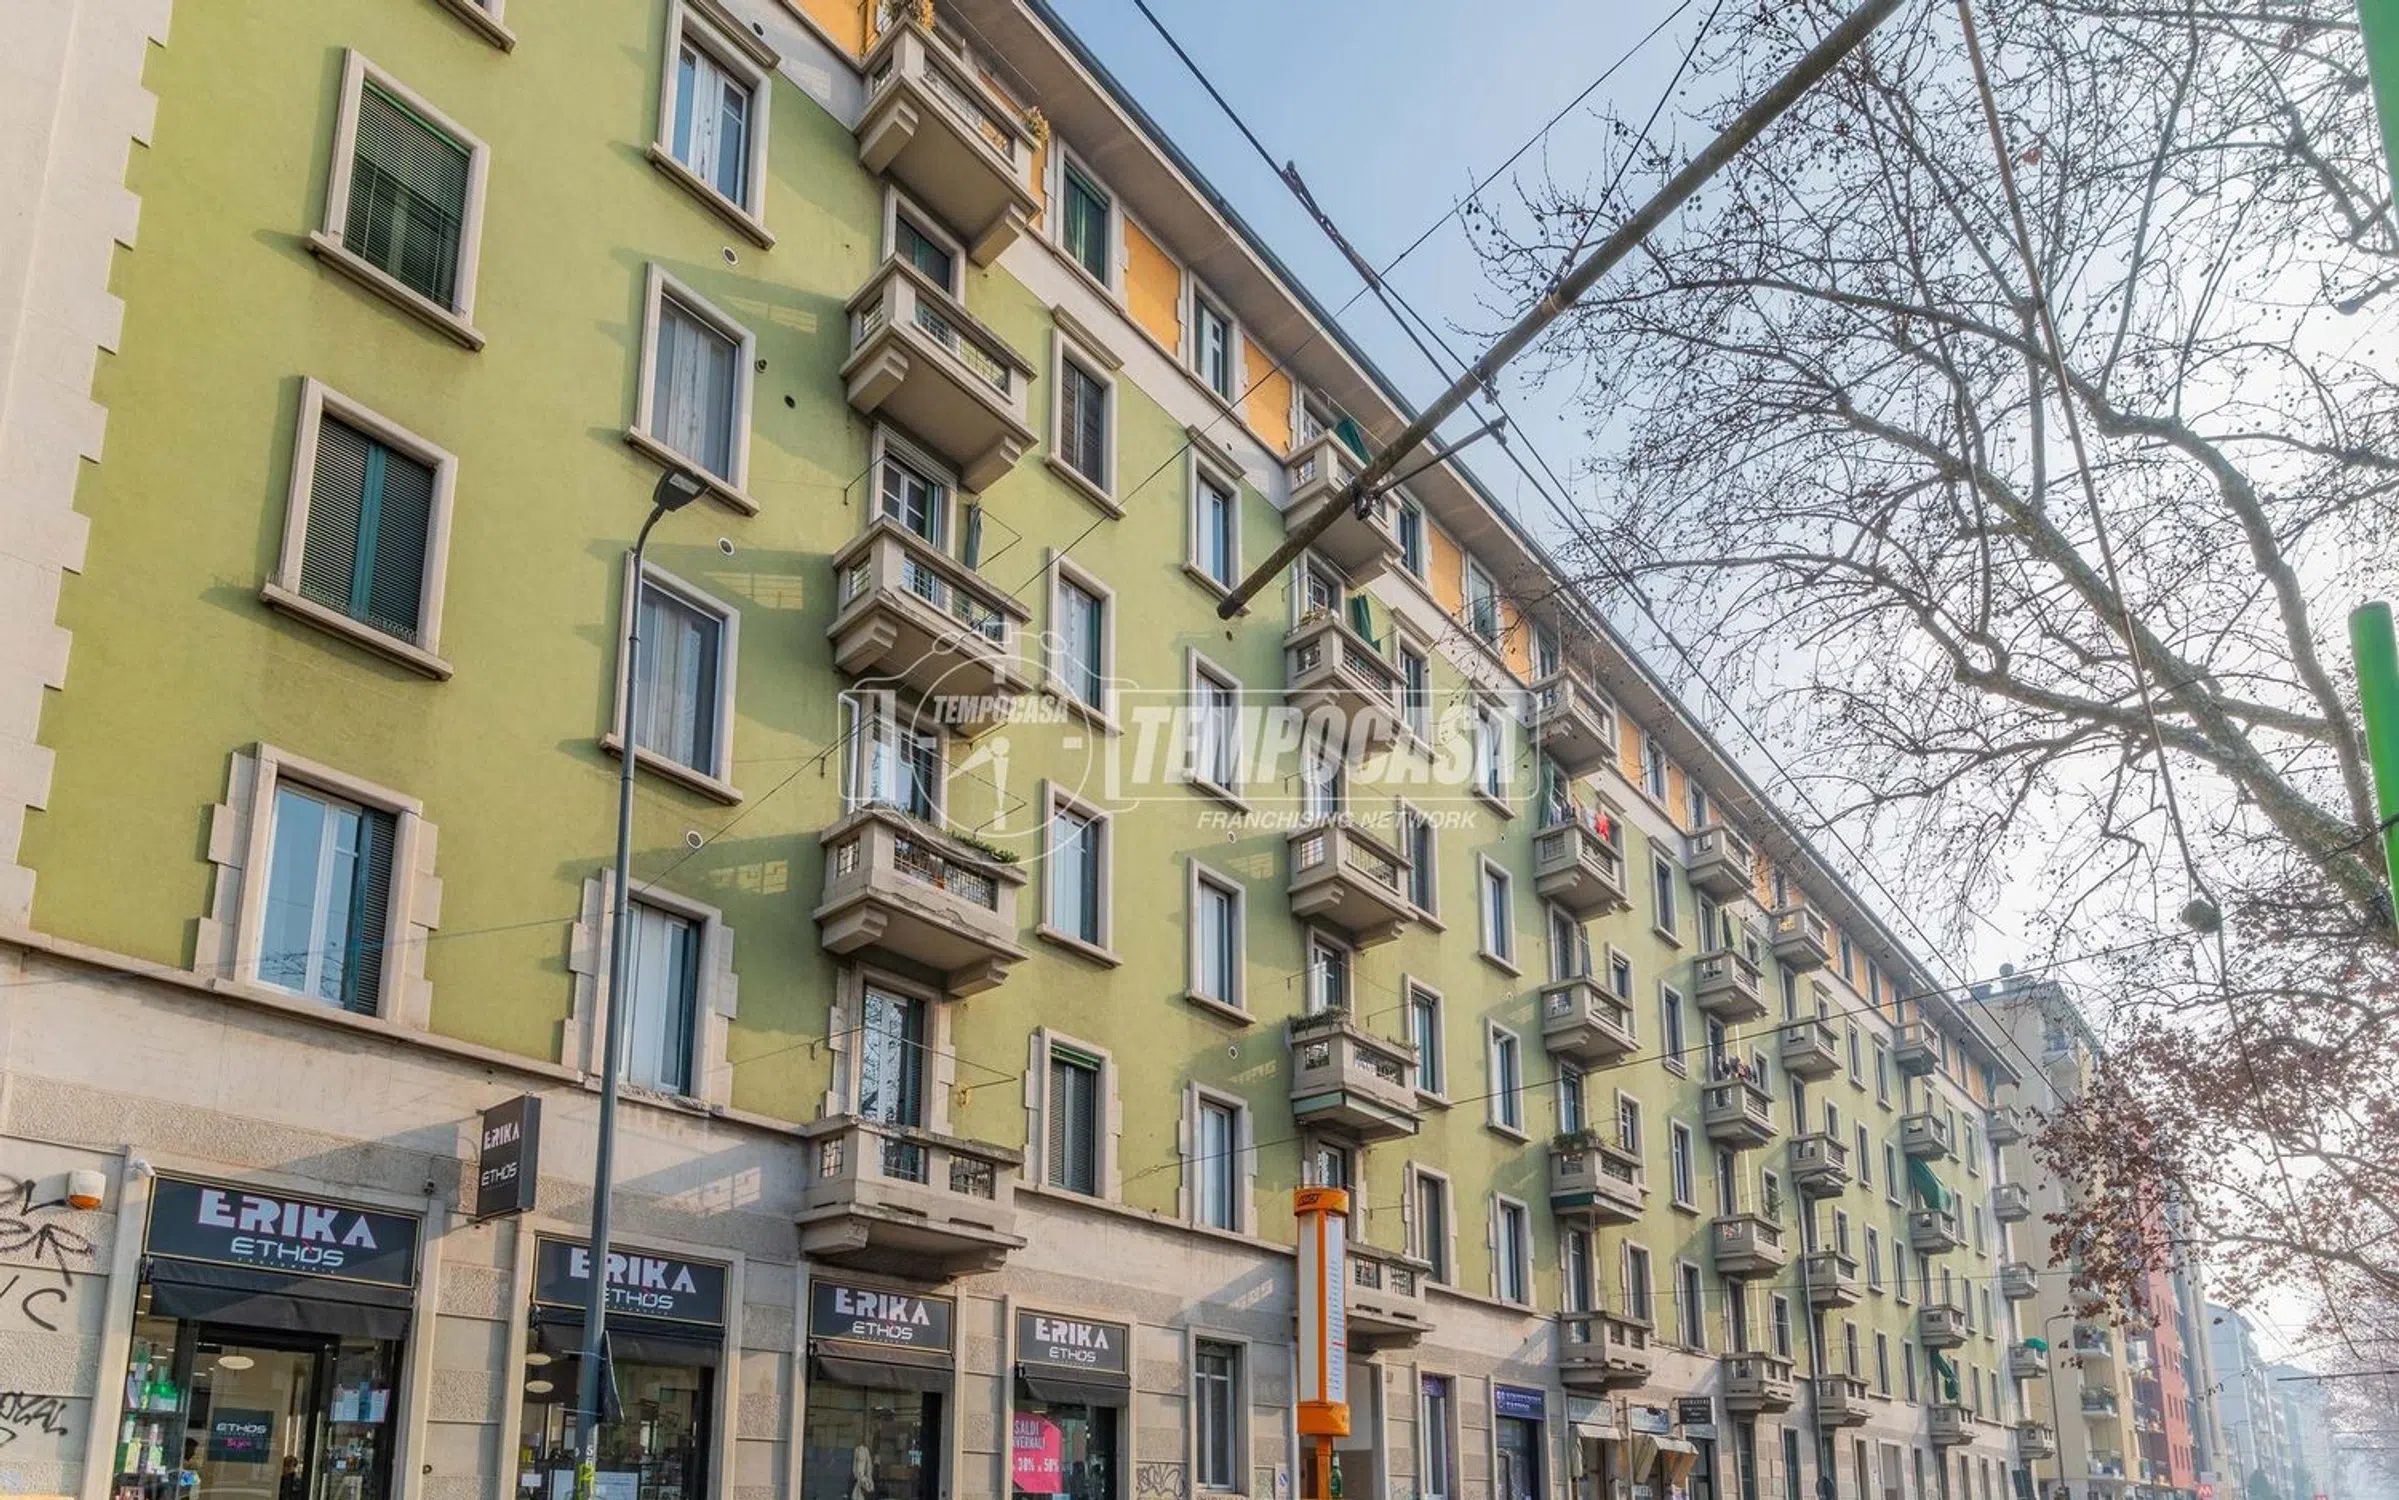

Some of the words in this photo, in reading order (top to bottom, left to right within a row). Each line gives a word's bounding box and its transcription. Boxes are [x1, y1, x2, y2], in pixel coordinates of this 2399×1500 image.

[483, 1121, 520, 1150] ERIKA
[481, 1162, 518, 1186] ETHOS
[198, 1188, 378, 1249] ERIKA
[230, 1236, 345, 1267] ETHOS
[569, 1247, 697, 1294] ERIKA
[835, 1287, 930, 1326] ERIKA
[852, 1320, 913, 1340] ETHOS
[1035, 1317, 1110, 1350] ERIKA
[1049, 1346, 1097, 1363] ETHOS
[216, 1422, 267, 1434] ETHOS
[1014, 1420, 1040, 1436] SALDI
[1018, 1457, 1035, 1472] 30%
